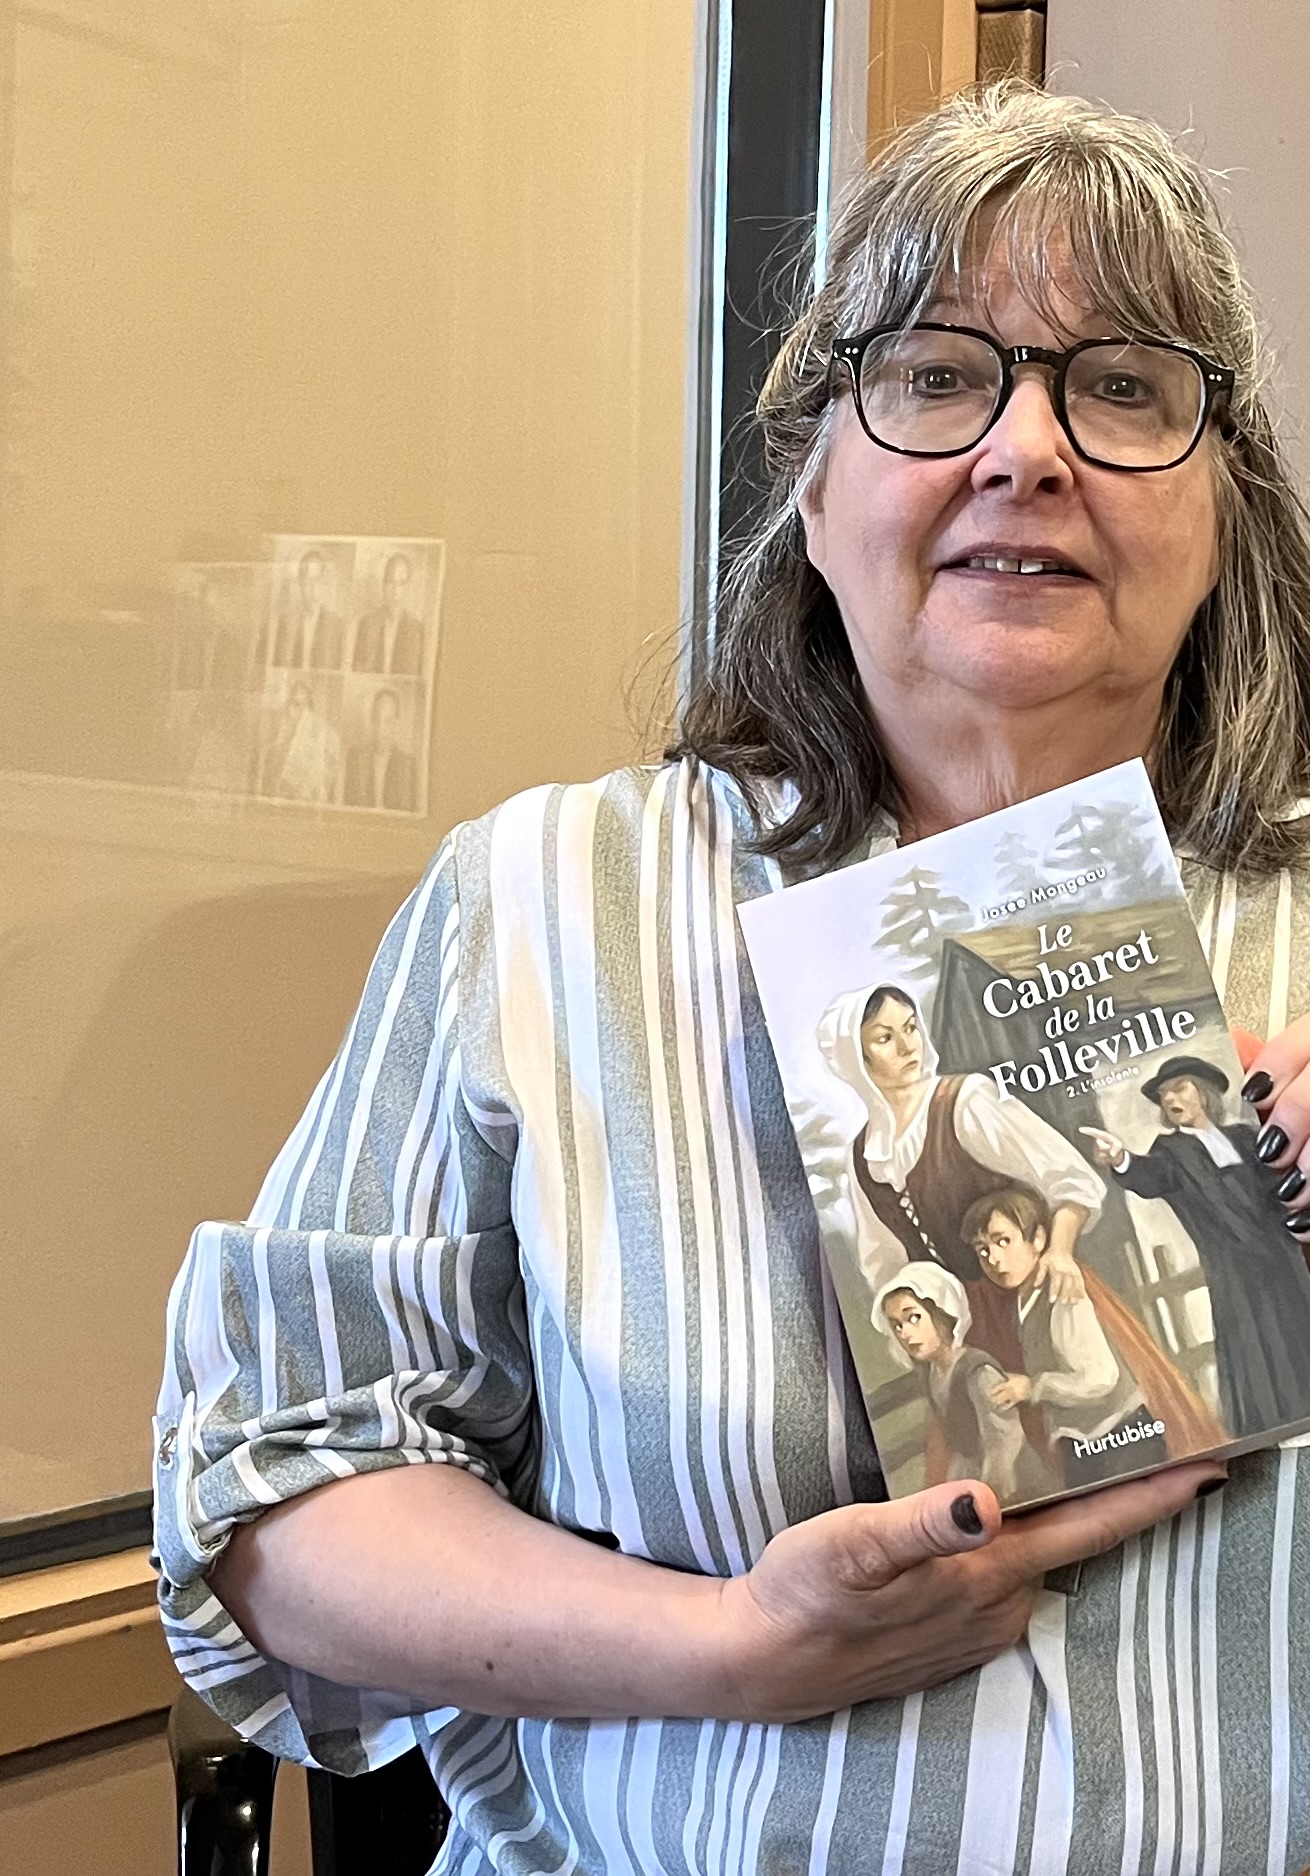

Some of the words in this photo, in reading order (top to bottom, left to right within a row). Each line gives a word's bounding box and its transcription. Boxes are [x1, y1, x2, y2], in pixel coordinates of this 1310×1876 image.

[1030, 867, 1107, 904] Mongeau
[1038, 923, 1073, 955] Le
[982, 929, 1159, 1018] Cabaret
[1044, 1006, 1080, 1039] de
[1085, 994, 1116, 1025] la
[988, 1006, 1198, 1101] Folleville
[1066, 1085, 1081, 1098] 2.
[1073, 1420, 1166, 1458] Hurtubise
